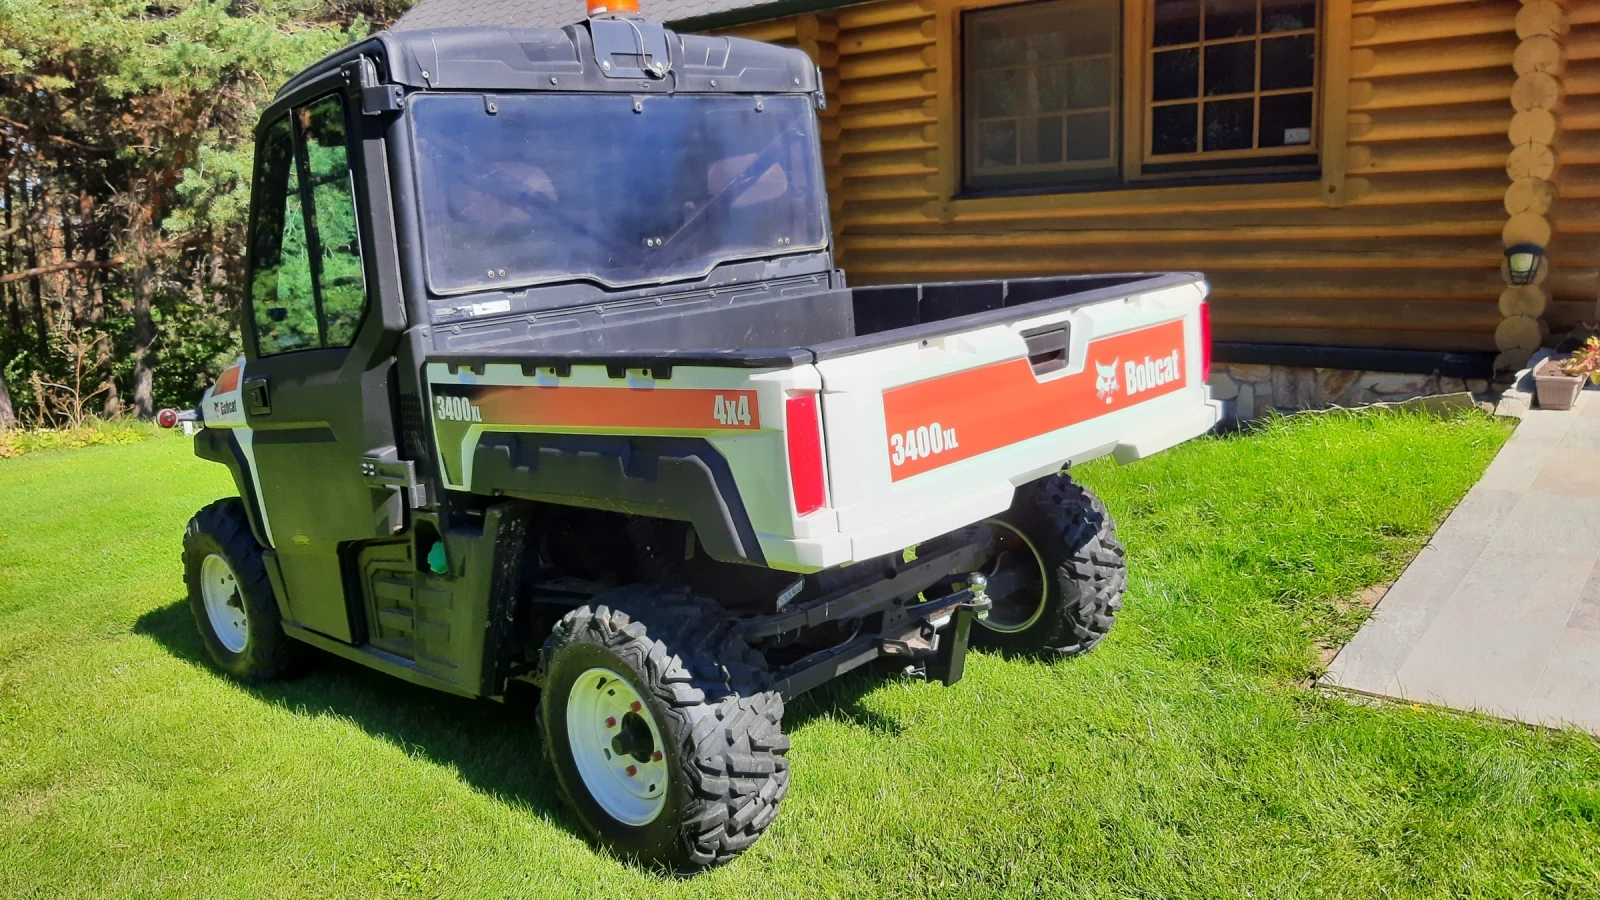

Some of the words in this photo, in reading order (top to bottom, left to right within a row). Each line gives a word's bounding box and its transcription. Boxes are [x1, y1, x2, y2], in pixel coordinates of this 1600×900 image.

[1124, 349, 1179, 395] Bobcat
[437, 396, 482, 422] 3400XL
[714, 395, 751, 425] 4x4
[891, 422, 959, 466] 3400XL
